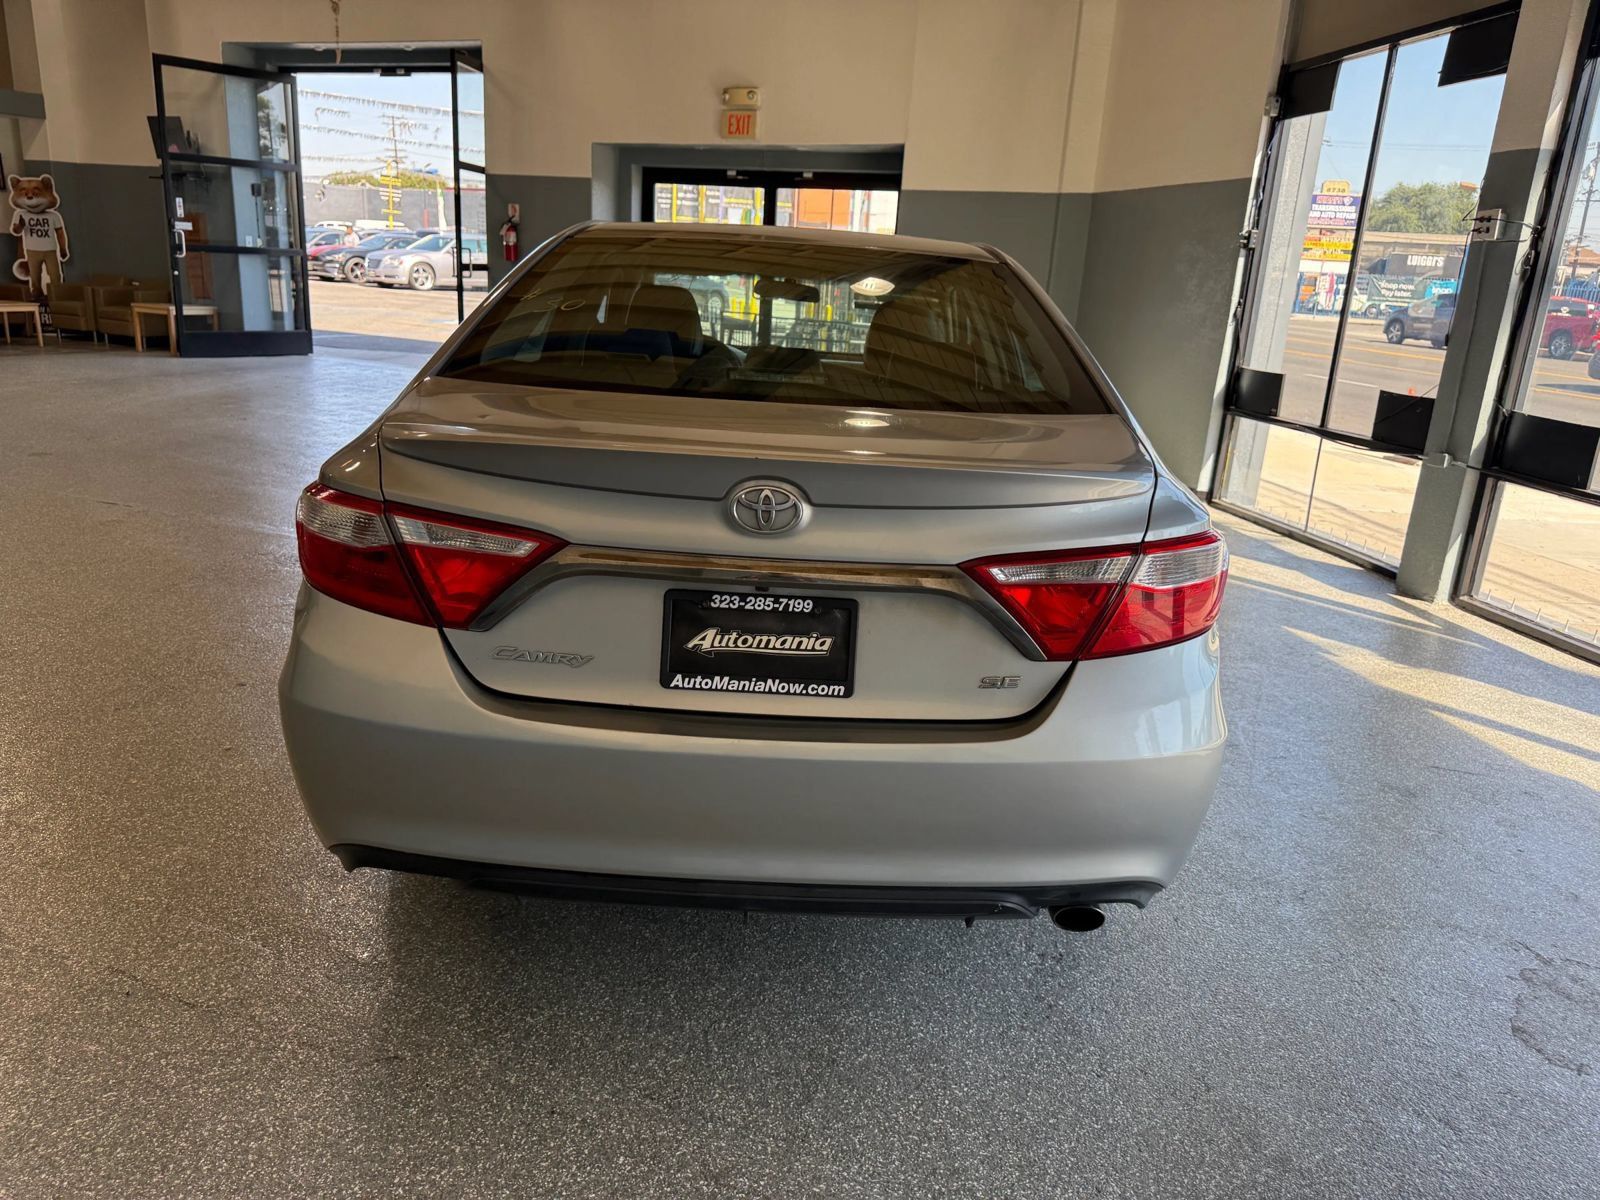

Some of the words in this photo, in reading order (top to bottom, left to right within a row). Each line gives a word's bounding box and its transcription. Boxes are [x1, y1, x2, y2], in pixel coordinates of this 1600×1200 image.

[728, 112, 753, 136] EXIT
[28, 217, 50, 228] CAR
[29, 228, 50, 238] FOX
[710, 594, 813, 613] 323-285-7199
[686, 627, 833, 652] Automania
[491, 645, 595, 668] CAMRY
[670, 673, 845, 696] AutoManiaNow.com
[978, 675, 1021, 689] SE
